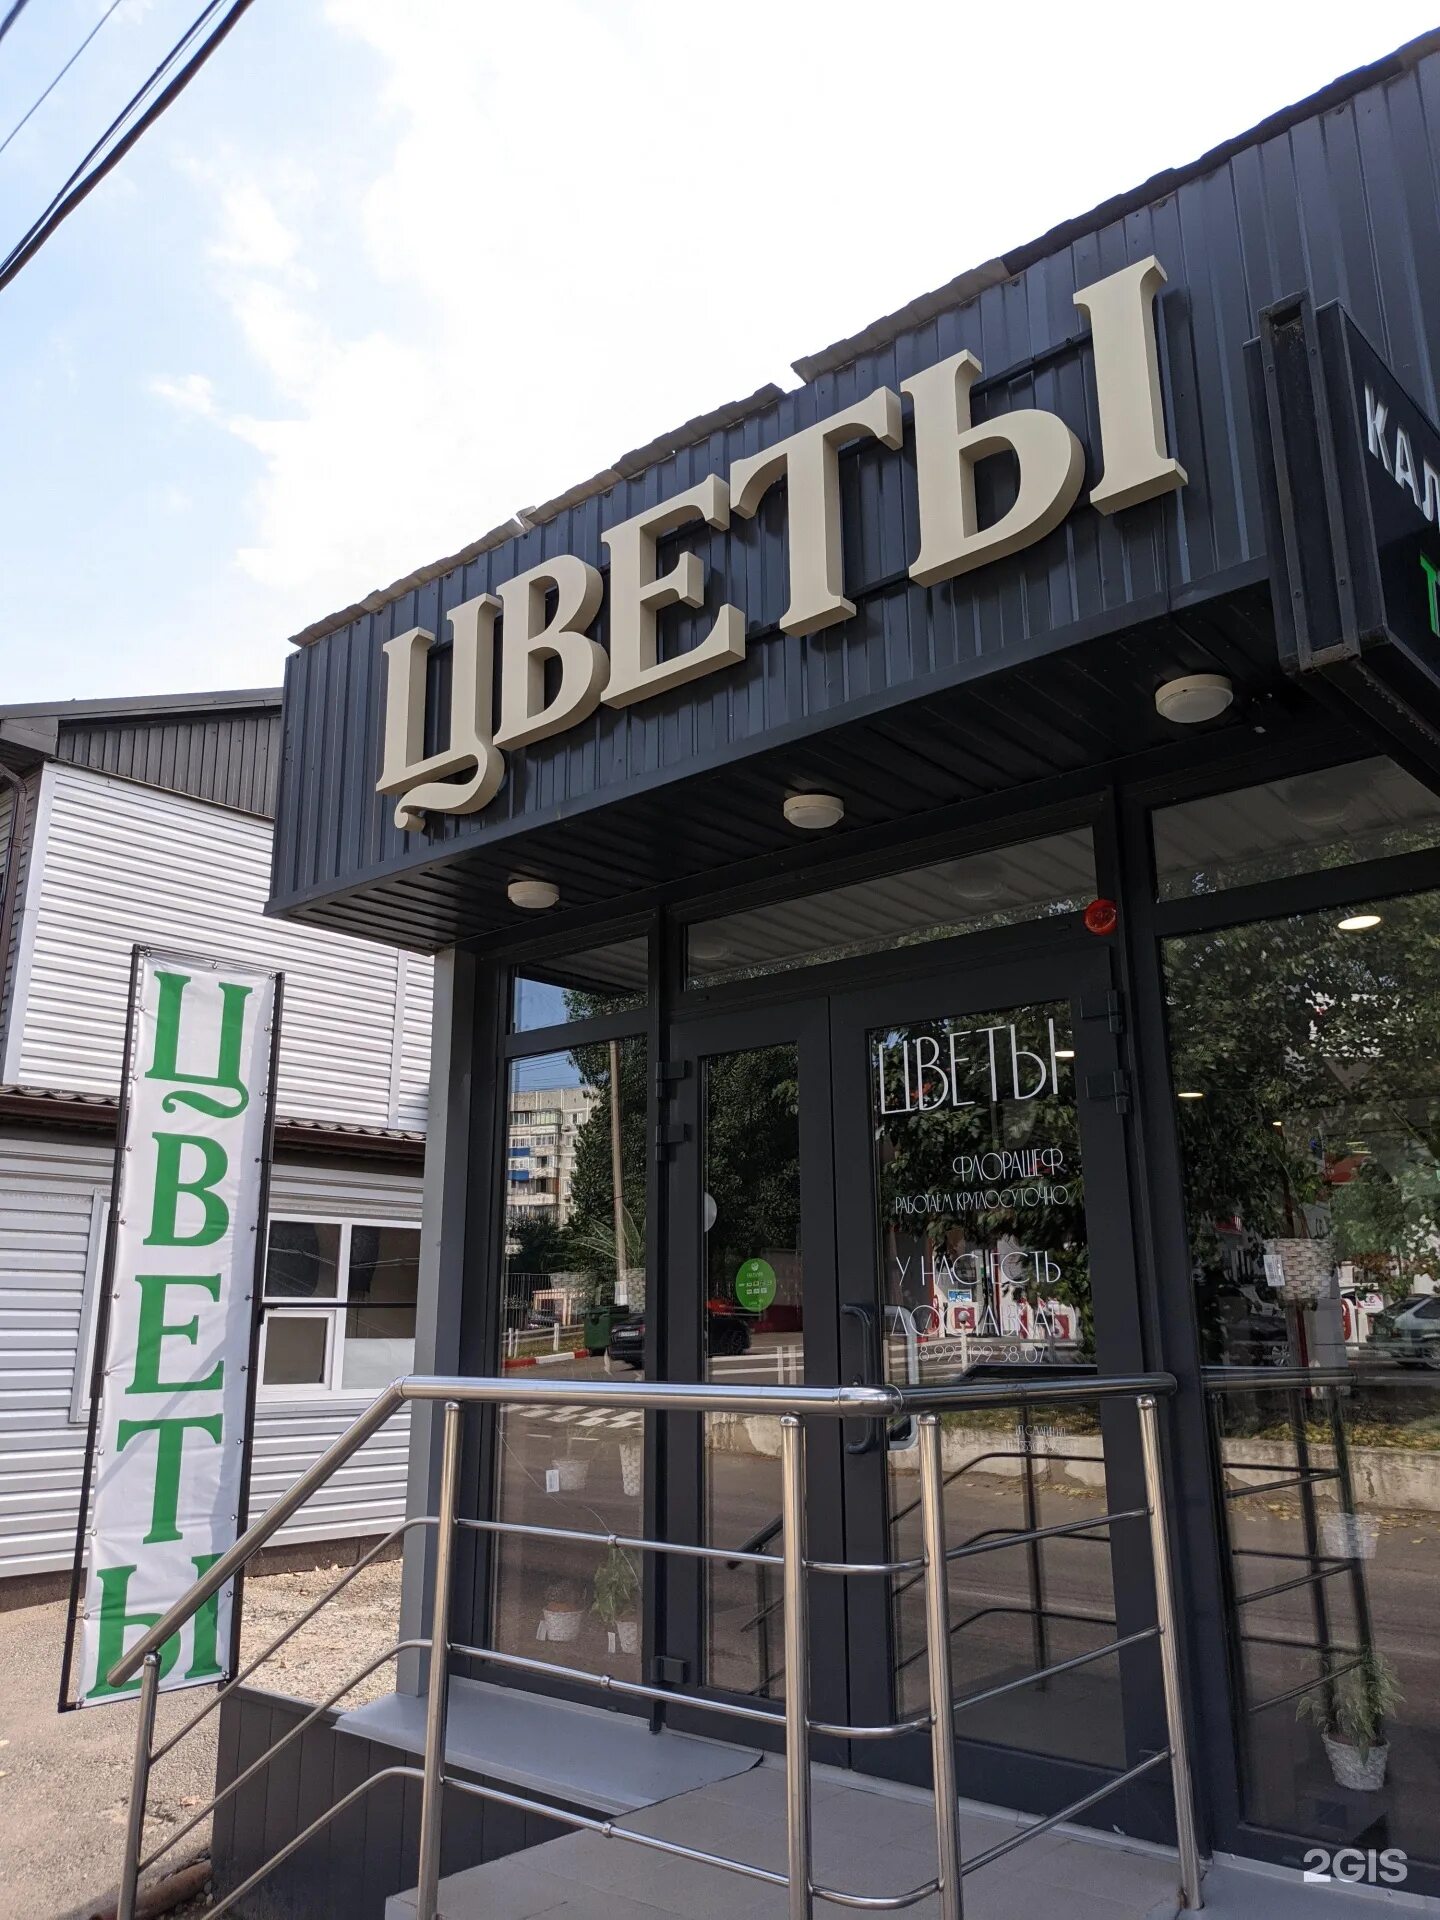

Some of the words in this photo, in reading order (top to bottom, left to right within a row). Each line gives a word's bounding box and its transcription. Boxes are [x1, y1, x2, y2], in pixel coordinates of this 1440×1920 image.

[375, 255, 1188, 830] ЦВЕТЫ
[879, 1018, 1058, 1115] ЦВЕТЫ
[952, 1147, 1064, 1182] ФЛОРАШЕФ
[895, 1192, 953, 1214] РАБОТАЕМ
[956, 1185, 1069, 1213] КРУГЛОСУТОЧНО
[895, 1256, 911, 1286] У
[921, 1253, 980, 1286] НАС
[990, 1250, 1061, 1285] ЕСТЬ
[85, 970, 251, 1699] ЦВЕТЫ
